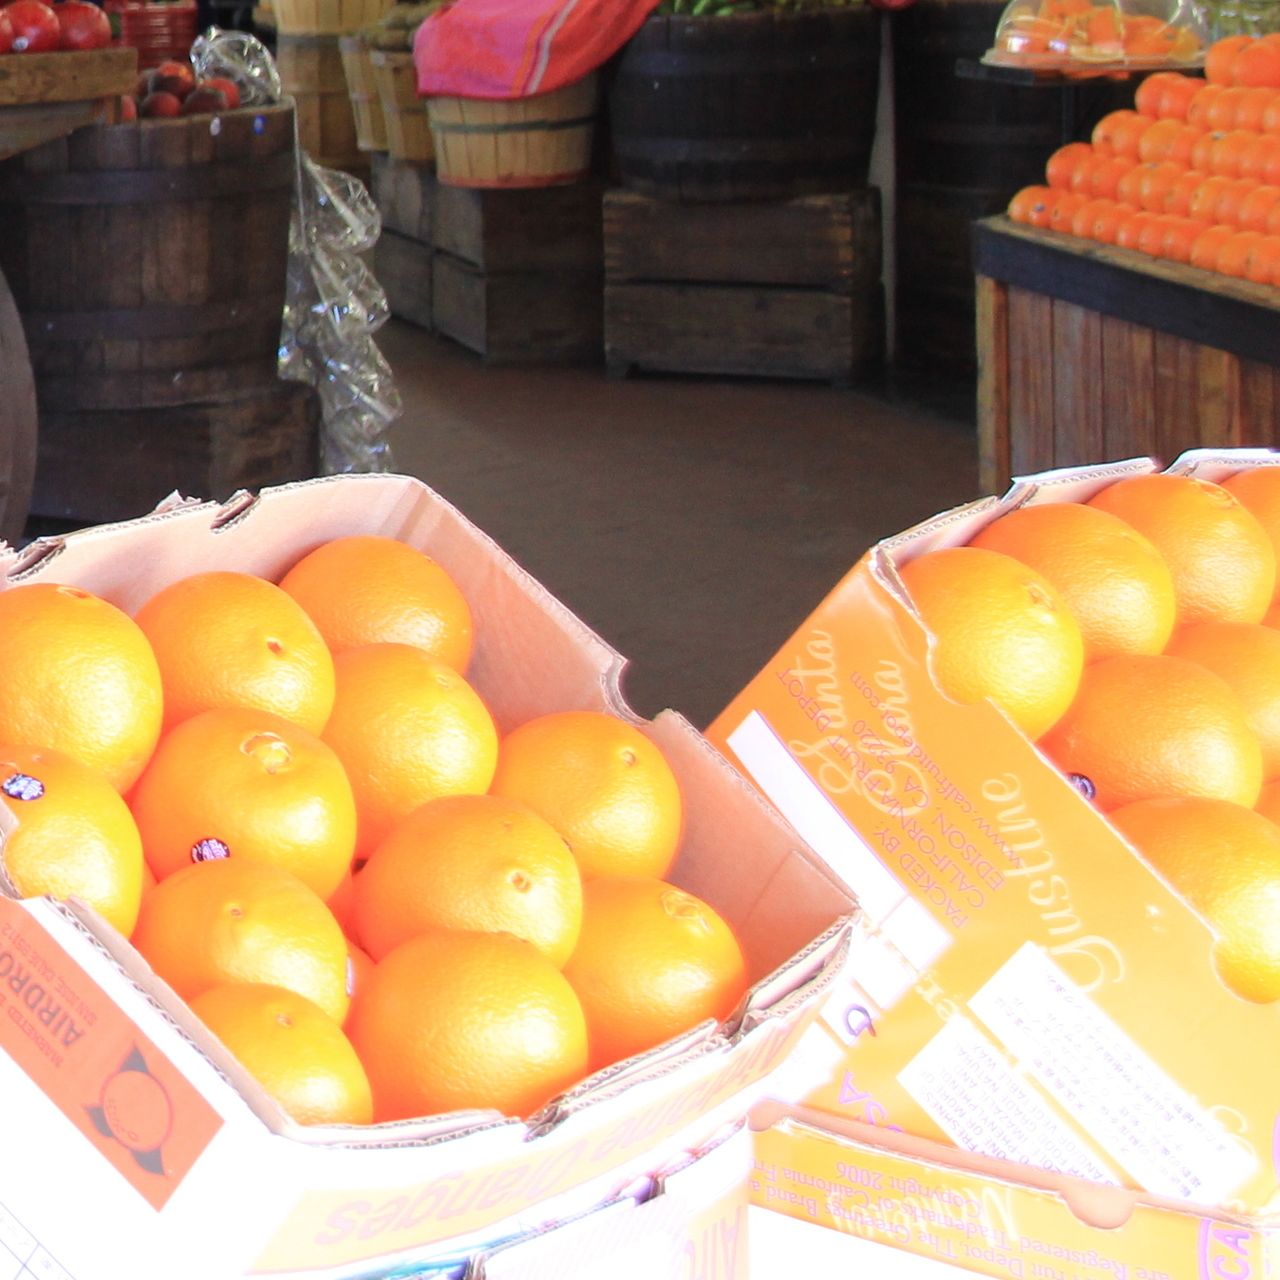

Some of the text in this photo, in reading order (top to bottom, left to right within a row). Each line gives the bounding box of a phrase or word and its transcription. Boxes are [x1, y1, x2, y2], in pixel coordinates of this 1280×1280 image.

[786, 631, 857, 799] Santa
[856, 661, 928, 819] Clara
[774, 665, 988, 910] CALIFORNIA FRUIT DEPOT
[846, 668, 1024, 867] www.calfruitdepot.com
[849, 716, 1007, 891] EDISON, CA 93220
[870, 820, 970, 928] PACKED BY:
[981, 771, 1125, 997] Gustine
[5, 1003, 63, 1067] MARKETED
[74, 1001, 97, 1025] SAN
[316, 1144, 590, 1246] Oranges
[765, 1182, 818, 1216] Brand
[781, 1166, 870, 1207] California
[834, 1161, 980, 1218] Copyright 2006
[874, 1196, 893, 1214] of
[823, 1199, 910, 1244] Greetings
[895, 1200, 1009, 1248] Trademarks
[917, 1229, 957, 1258] The
[1018, 1235, 1127, 1278] Registered
